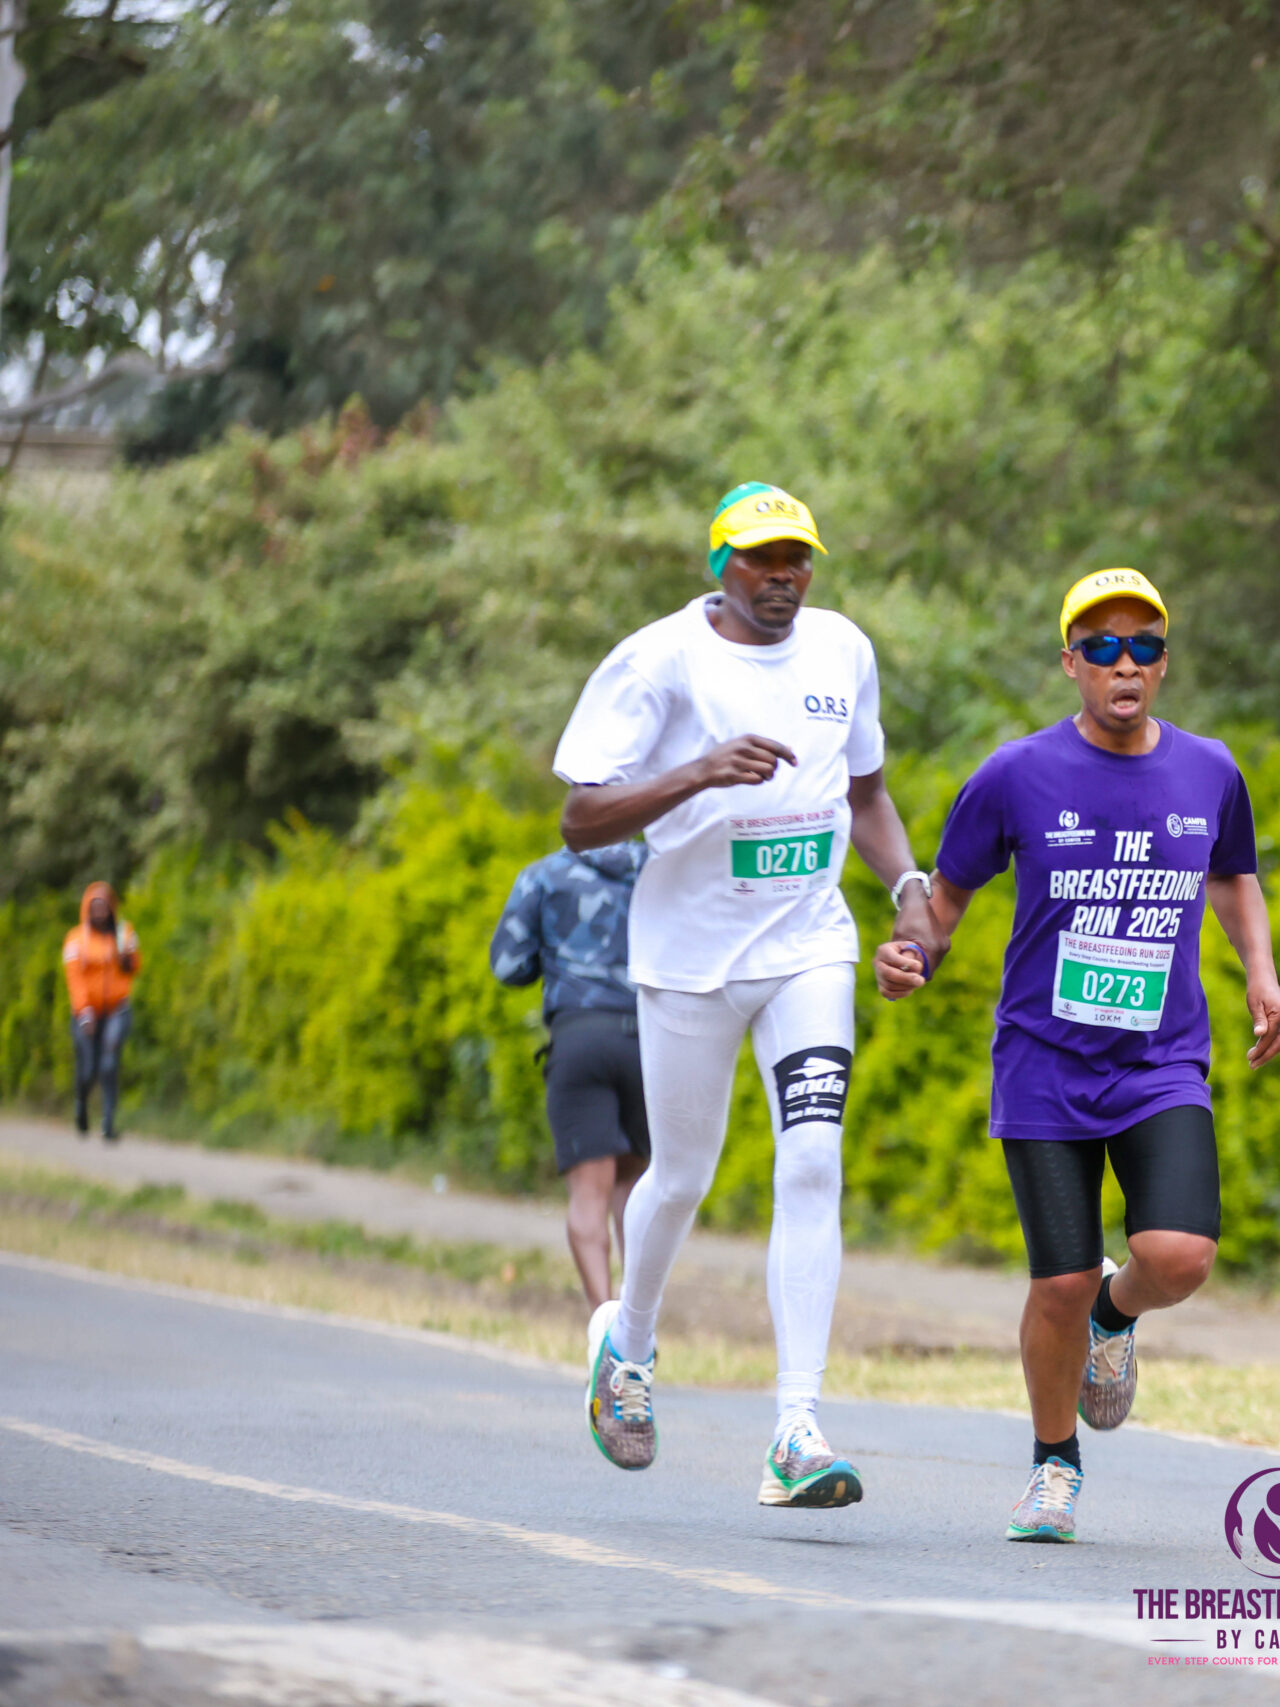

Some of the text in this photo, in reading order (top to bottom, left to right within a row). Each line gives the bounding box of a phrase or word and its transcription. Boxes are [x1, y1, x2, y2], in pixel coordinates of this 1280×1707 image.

[756, 840, 818, 875] 0276
[1113, 831, 1154, 862] THE
[1050, 868, 1204, 900] BREASTFEEDING
[1070, 905, 1183, 938] RUN 2025
[1064, 937, 1077, 949] THE
[1078, 940, 1137, 957] BREASTFEEDING
[1139, 948, 1154, 959] RUN
[1082, 970, 1146, 1007] 0273
[1094, 1014, 1122, 1023] 10KM
[785, 1073, 846, 1100] enda
